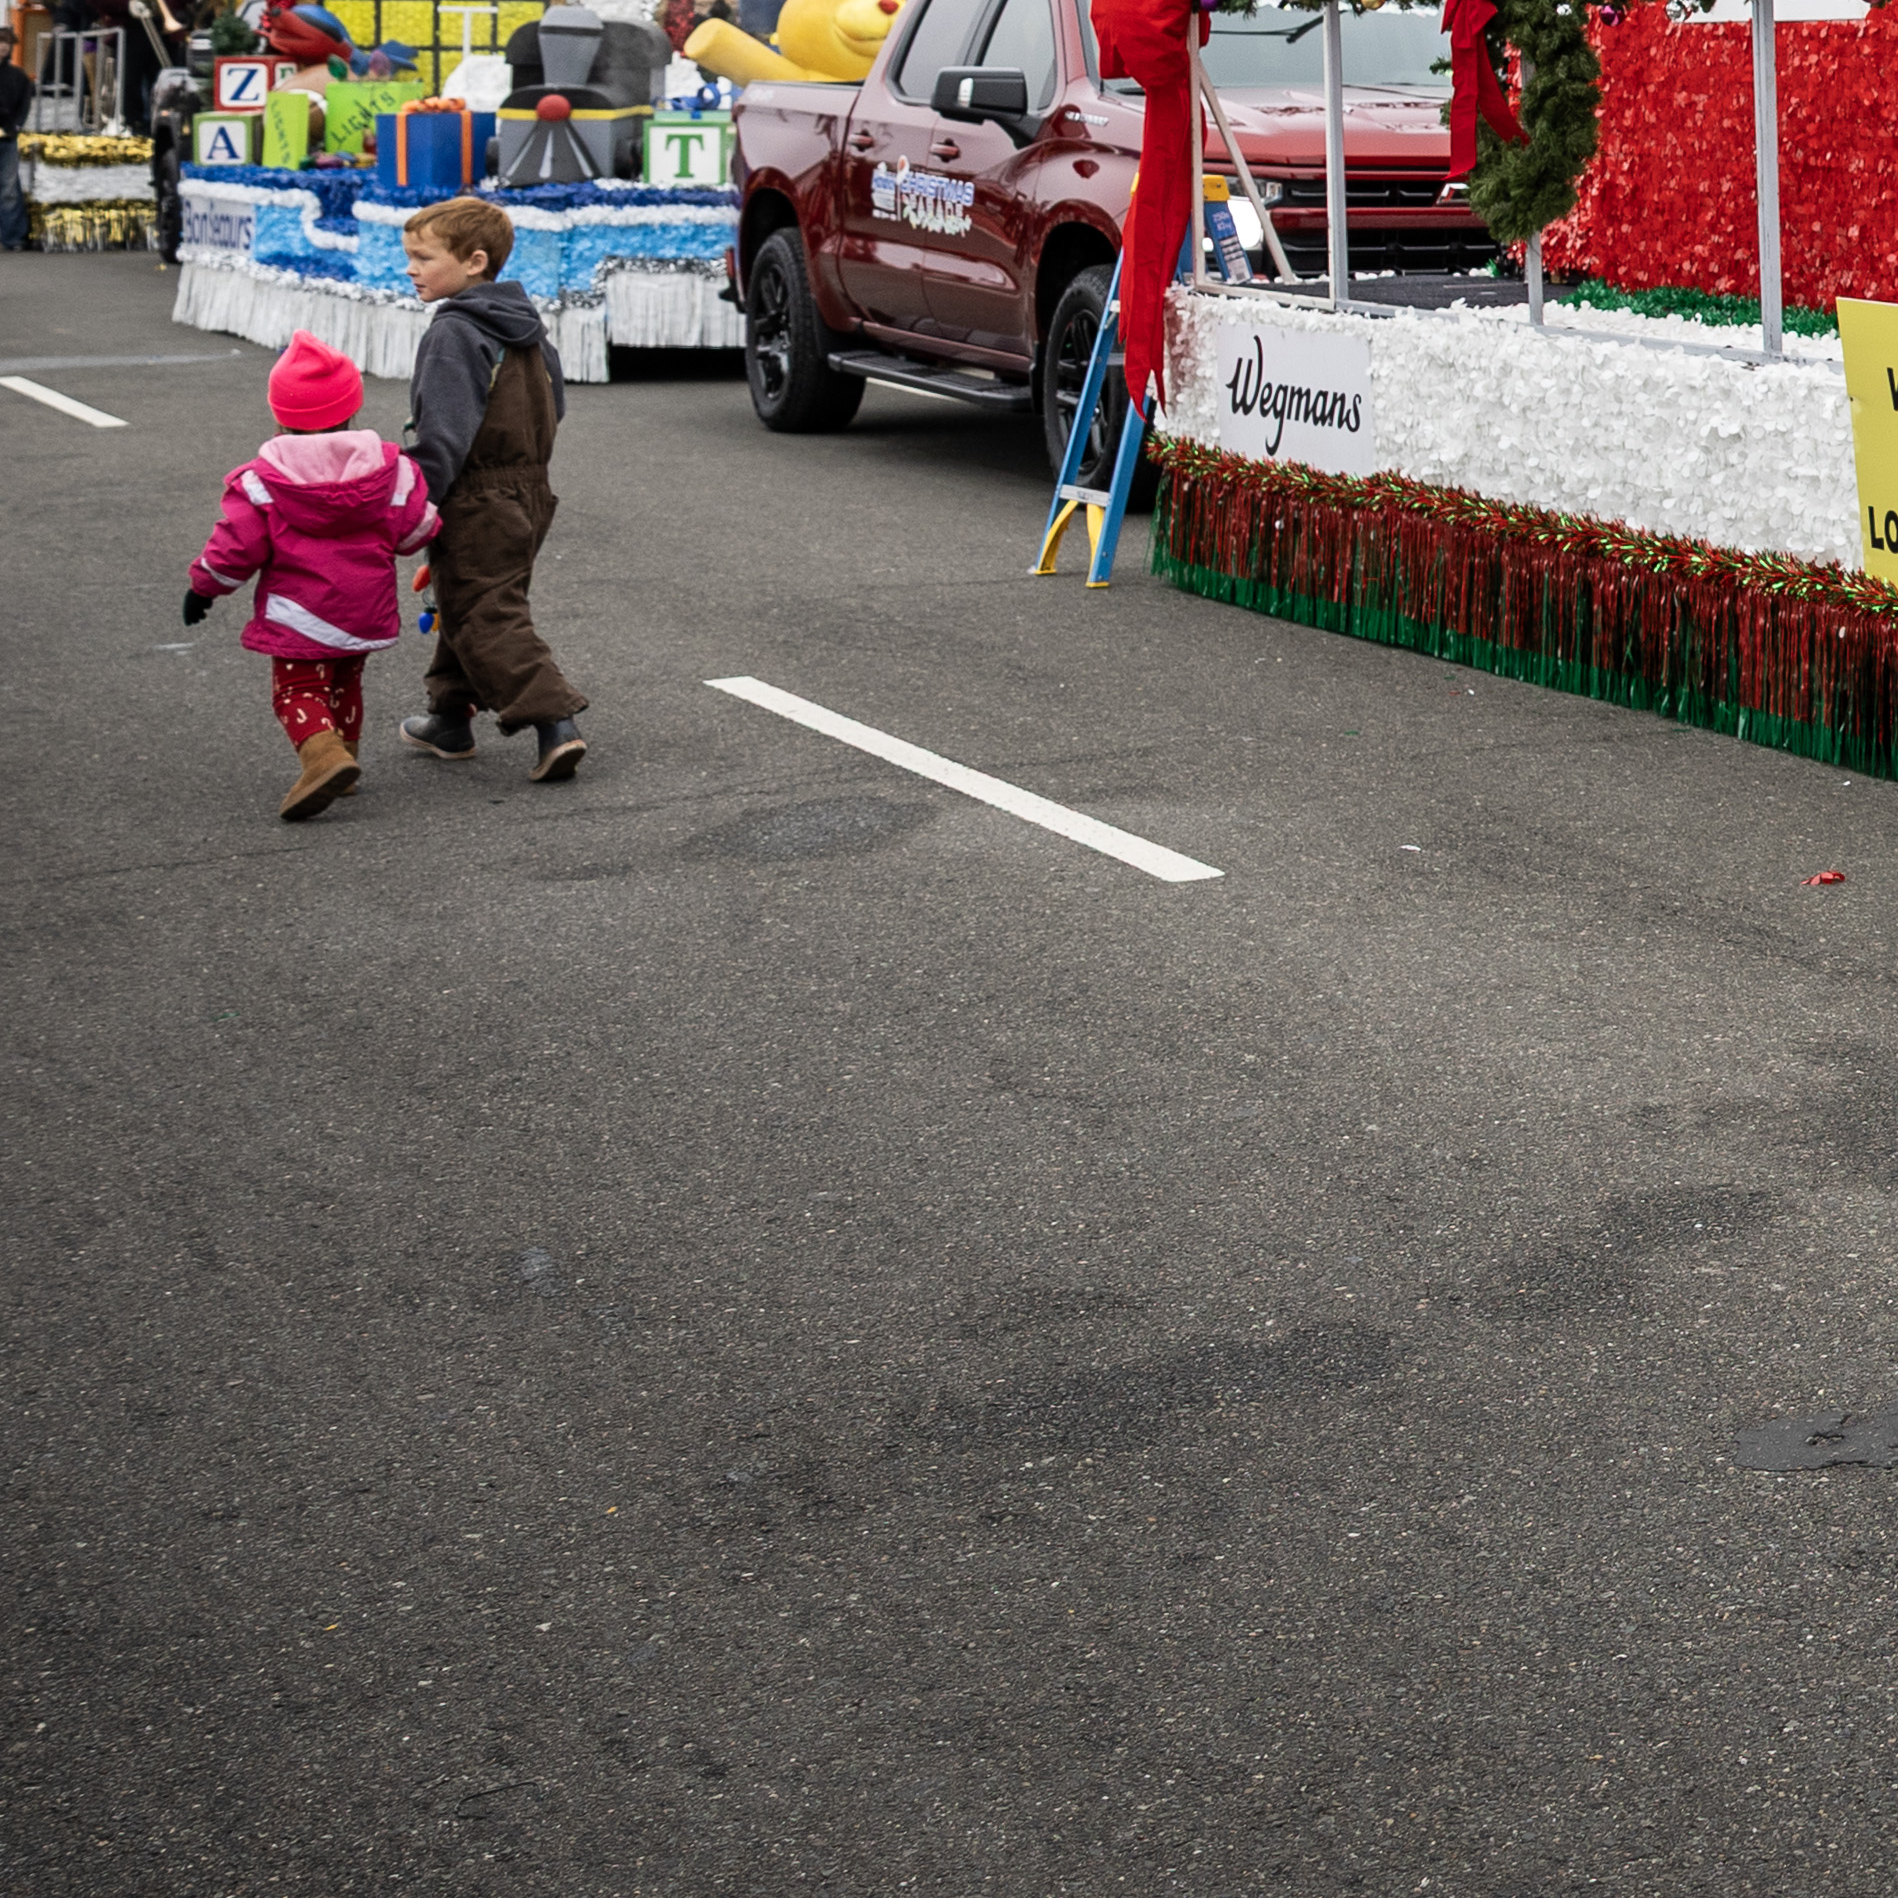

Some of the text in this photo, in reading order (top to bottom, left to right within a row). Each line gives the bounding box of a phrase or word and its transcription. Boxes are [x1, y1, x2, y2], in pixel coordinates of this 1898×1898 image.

[228, 68, 260, 101] Z
[207, 126, 241, 159] A
[665, 134, 705, 178] T
[1225, 335, 1362, 457] Wegmans
